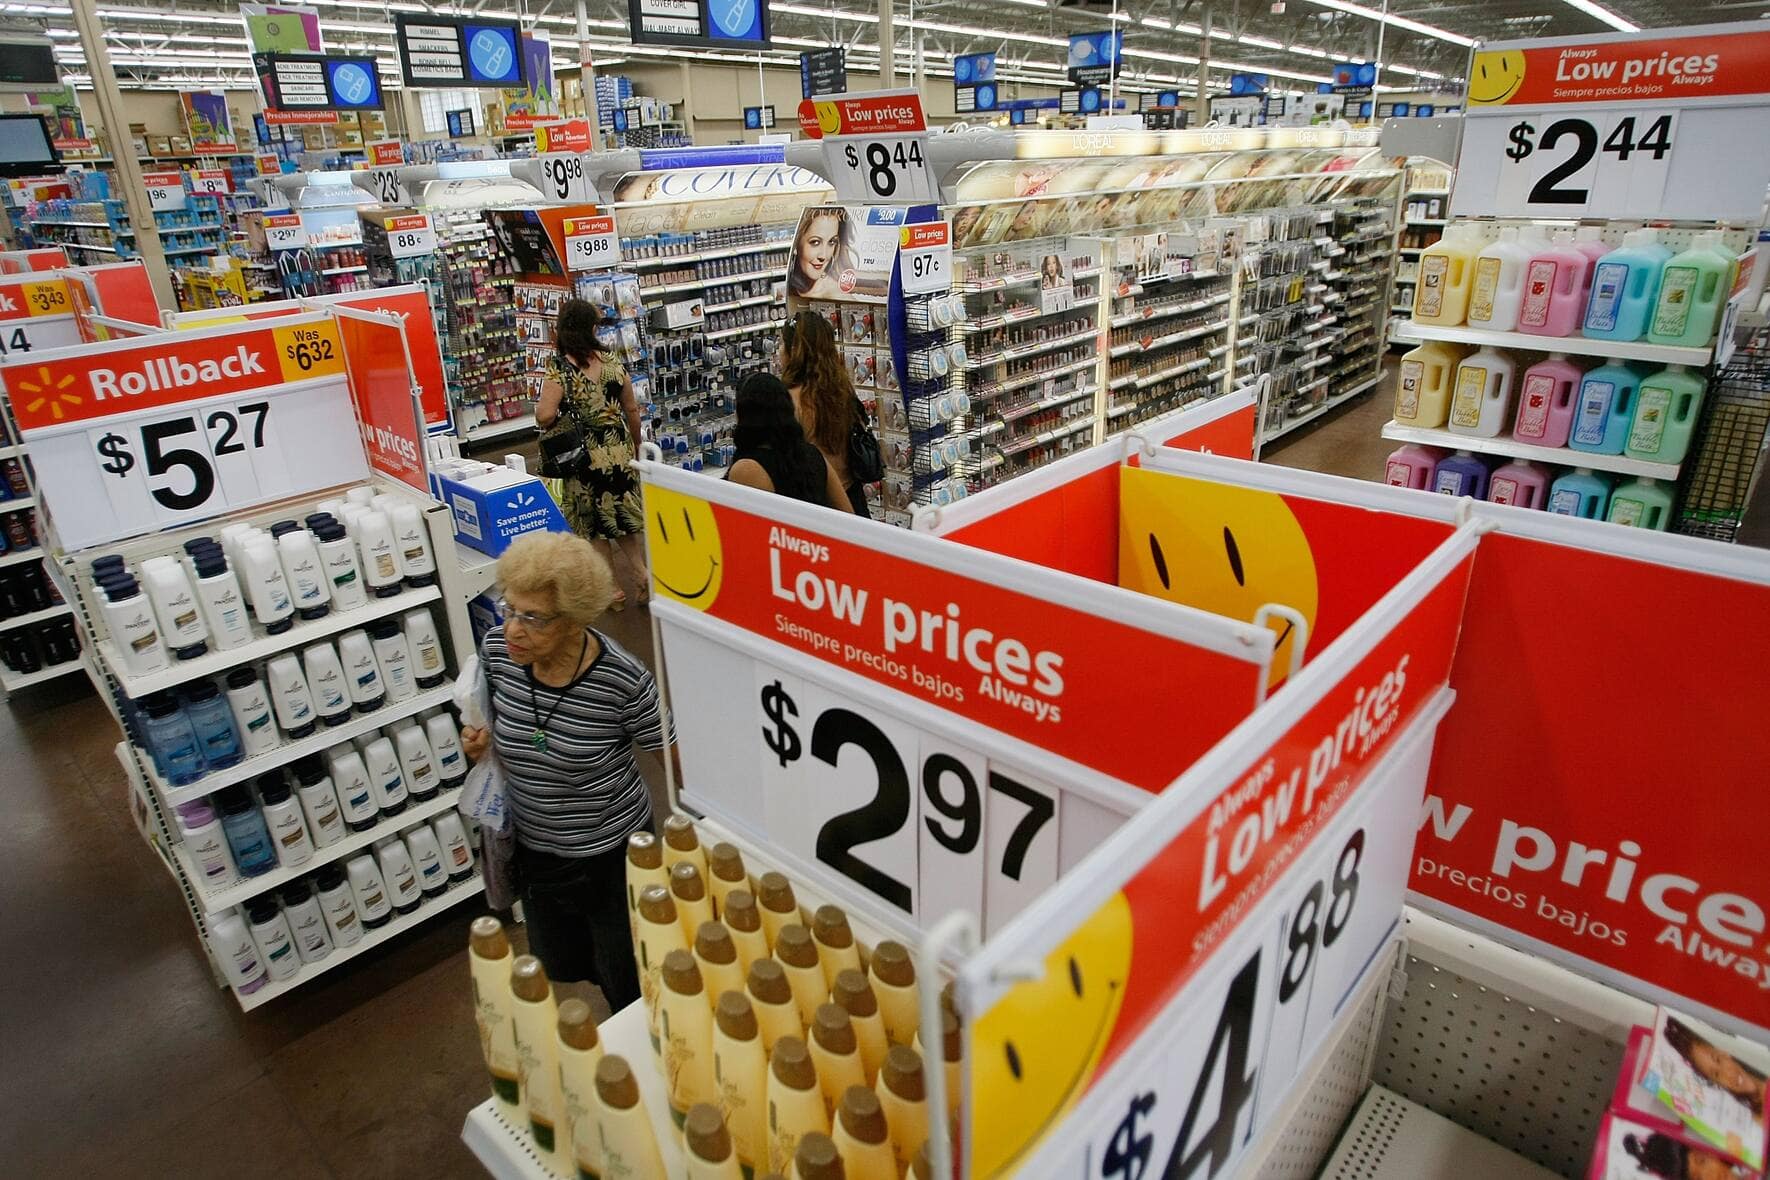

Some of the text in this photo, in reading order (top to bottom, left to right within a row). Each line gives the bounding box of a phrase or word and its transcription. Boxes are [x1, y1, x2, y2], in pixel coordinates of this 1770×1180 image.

[1556, 51, 1720, 84] Low prices
[1559, 49, 1598, 59] Always
[1553, 84, 1664, 98] Siempre precios bajos
[1671, 74, 1714, 85] Always
[846, 105, 914, 124] Low prices
[578, 222, 608, 231] Low prices
[914, 230, 944, 241] Low prices
[35, 285, 55, 293] Was
[293, 328, 320, 343] Was
[88, 346, 266, 400] Rollback
[376, 425, 417, 461] prices
[496, 507, 550, 528] Save money.
[500, 518, 549, 538] Live better.
[768, 525, 830, 563] Always
[769, 547, 1065, 697] Low prices
[774, 613, 964, 703] Siempre precios bajos
[978, 674, 1063, 724] Always
[1303, 653, 1410, 815] prices
[1206, 756, 1276, 837] Always
[1198, 767, 1302, 913] Low
[1417, 856, 1629, 947] precios bajos
[1491, 818, 1770, 958] price
